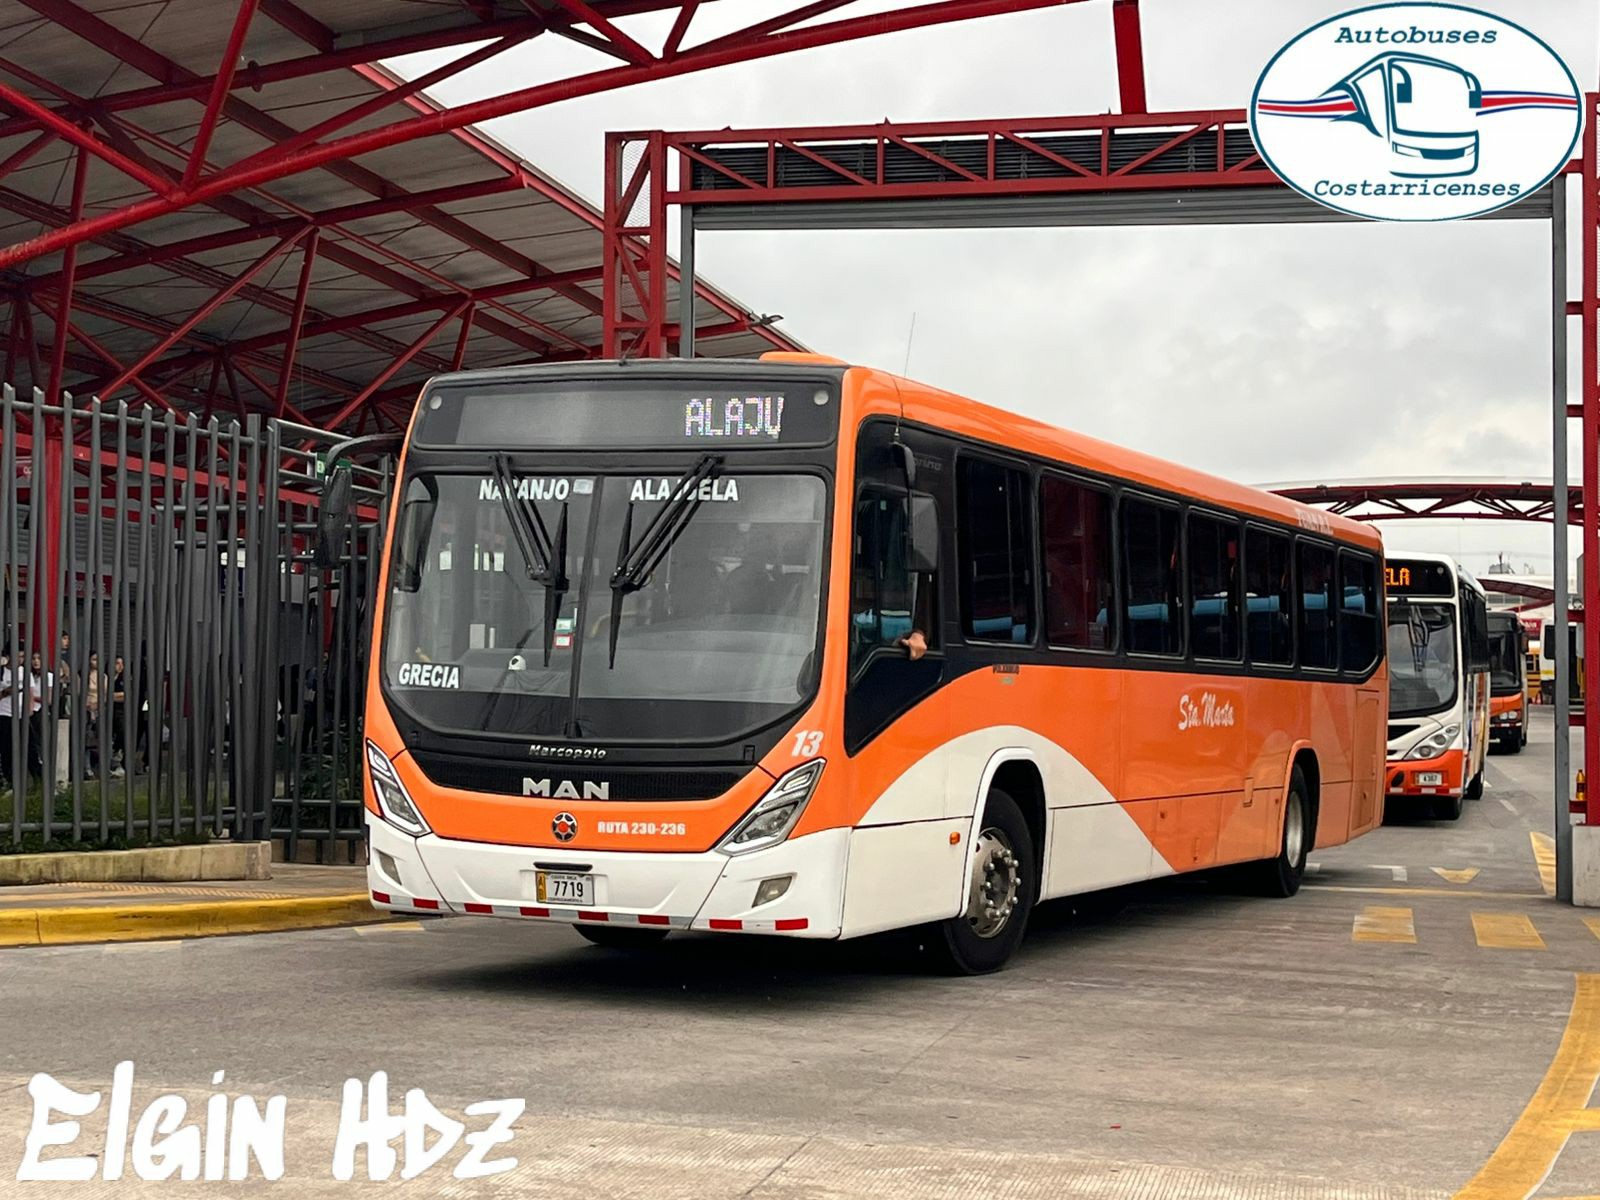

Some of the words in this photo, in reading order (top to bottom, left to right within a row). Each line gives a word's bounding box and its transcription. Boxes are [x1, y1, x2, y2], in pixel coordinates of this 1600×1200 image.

[399, 662, 459, 689] GRECIA
[529, 744, 607, 759] Marcopolo
[791, 730, 825, 757] 13
[522, 777, 610, 801] MAN
[597, 820, 629, 834] RUTA
[631, 821, 686, 836] 230-236
[553, 880, 583, 897] 7719
